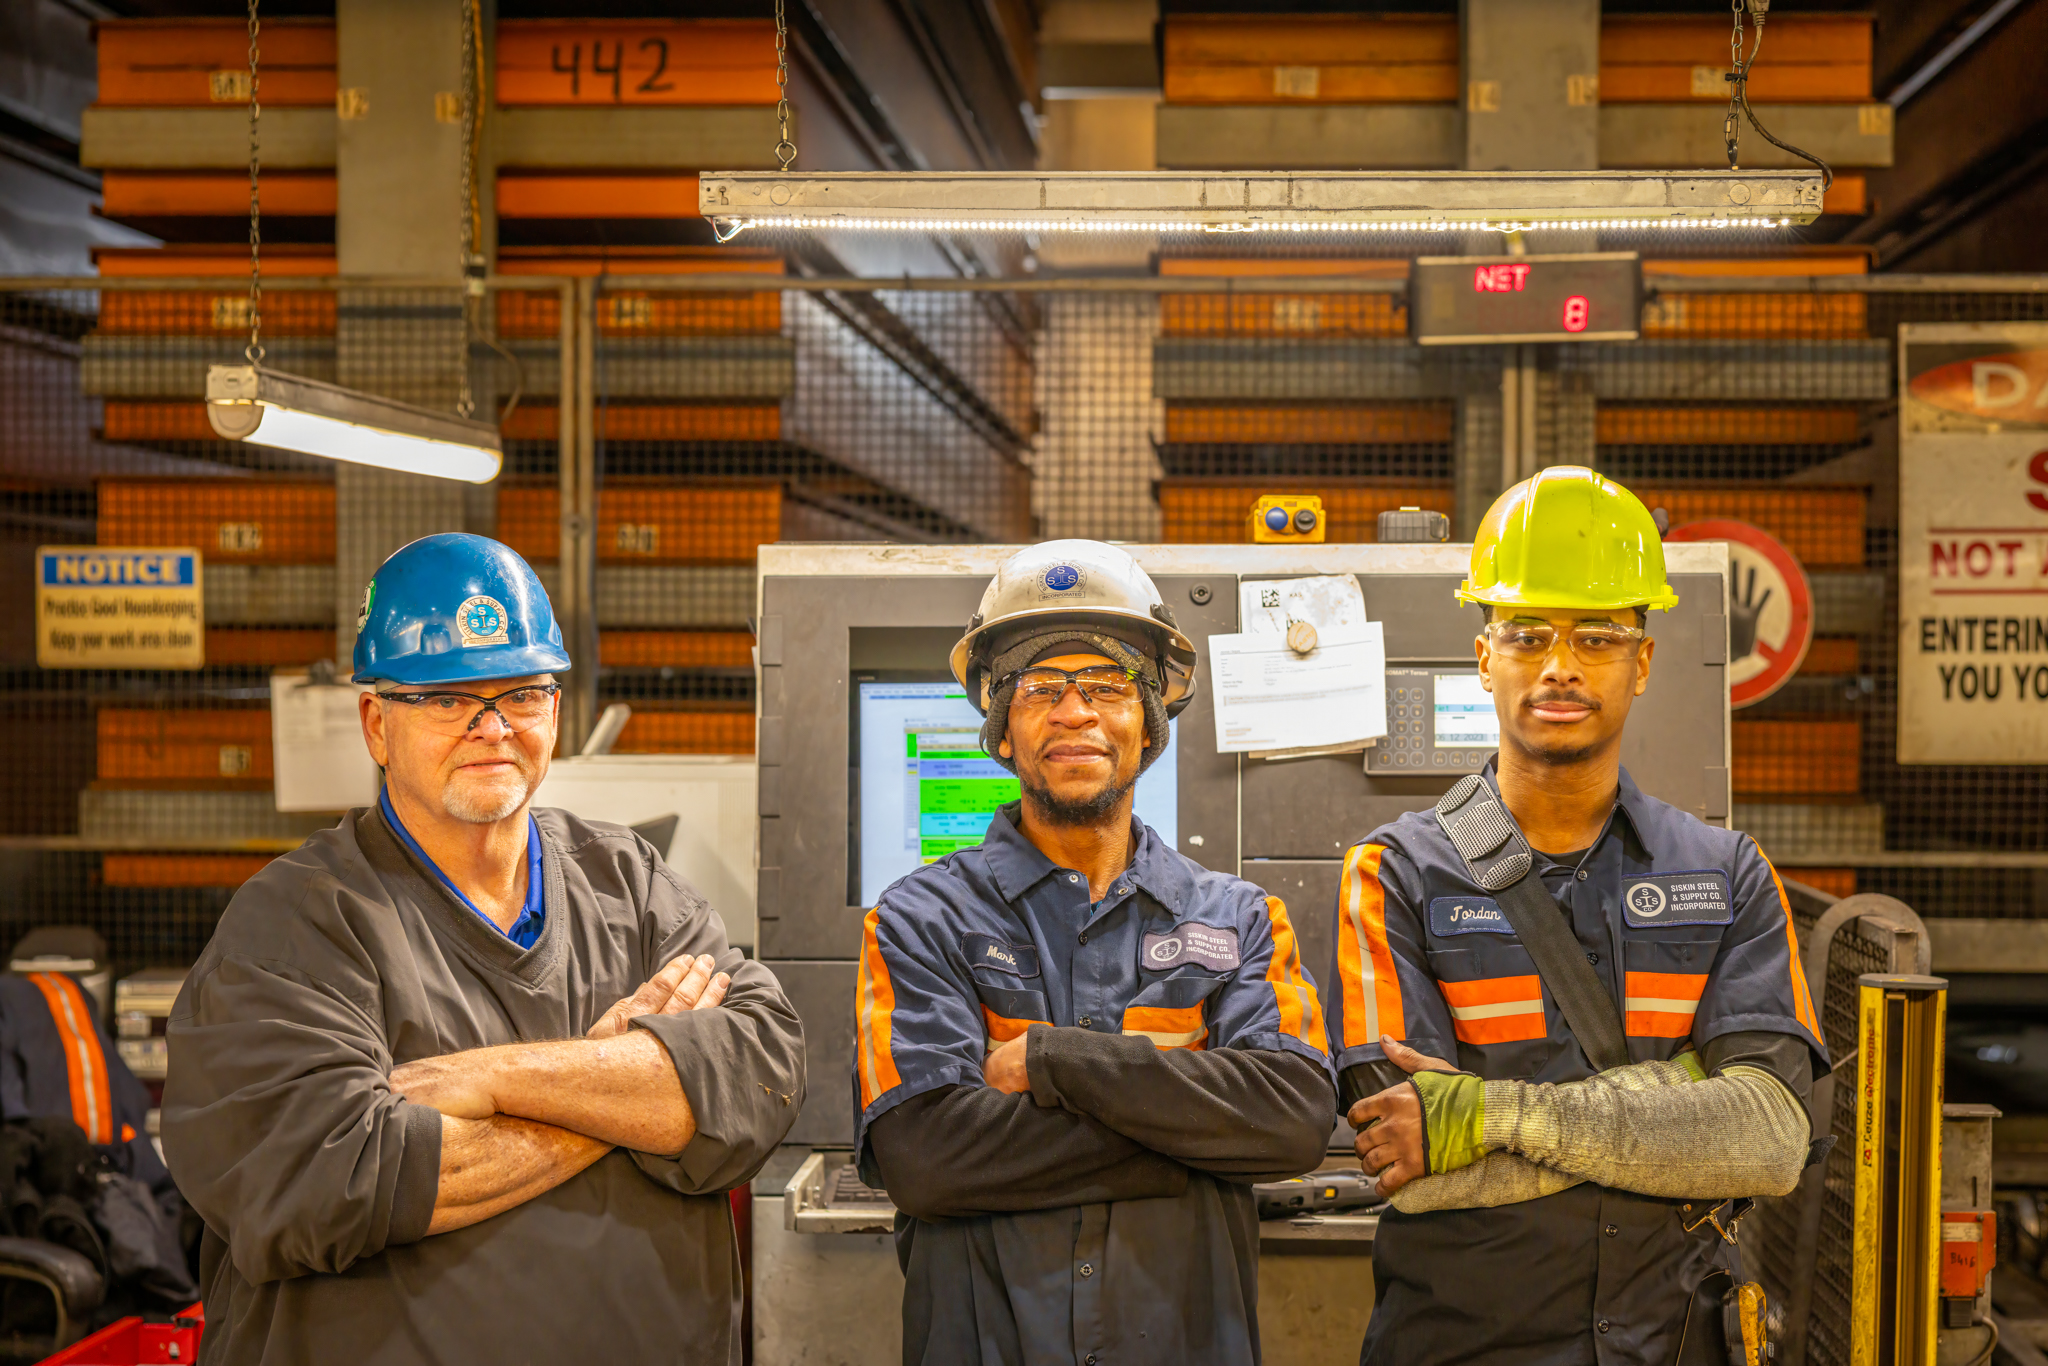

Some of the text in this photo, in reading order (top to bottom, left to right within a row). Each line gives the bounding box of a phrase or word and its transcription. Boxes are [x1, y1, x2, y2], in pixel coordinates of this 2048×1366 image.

[553, 37, 676, 98] 442
[1474, 263, 1531, 293] NET
[1563, 295, 1589, 333] 8
[1972, 362, 2048, 409] D
[1930, 540, 2024, 579] NOT
[57, 557, 180, 584] NOTICE
[1042, 592, 1083, 600] INCORPORATED
[1937, 663, 2002, 701] YOU
[1670, 882, 1720, 892] SISKIN STEEL
[1680, 893, 1708, 901] SUPPLY
[1709, 892, 1722, 900] CO.
[1450, 905, 1502, 922] Jordan
[1670, 902, 1726, 911] INCORPORATED
[1187, 932, 1228, 945] SISKIN STEEL
[1194, 939, 1217, 951] SUPPLY
[986, 945, 1017, 966] Mark
[1186, 946, 1233, 960] INCORPORATED
[1866, 1028, 1875, 1098] electronic
[1950, 1252, 1975, 1268] B416
